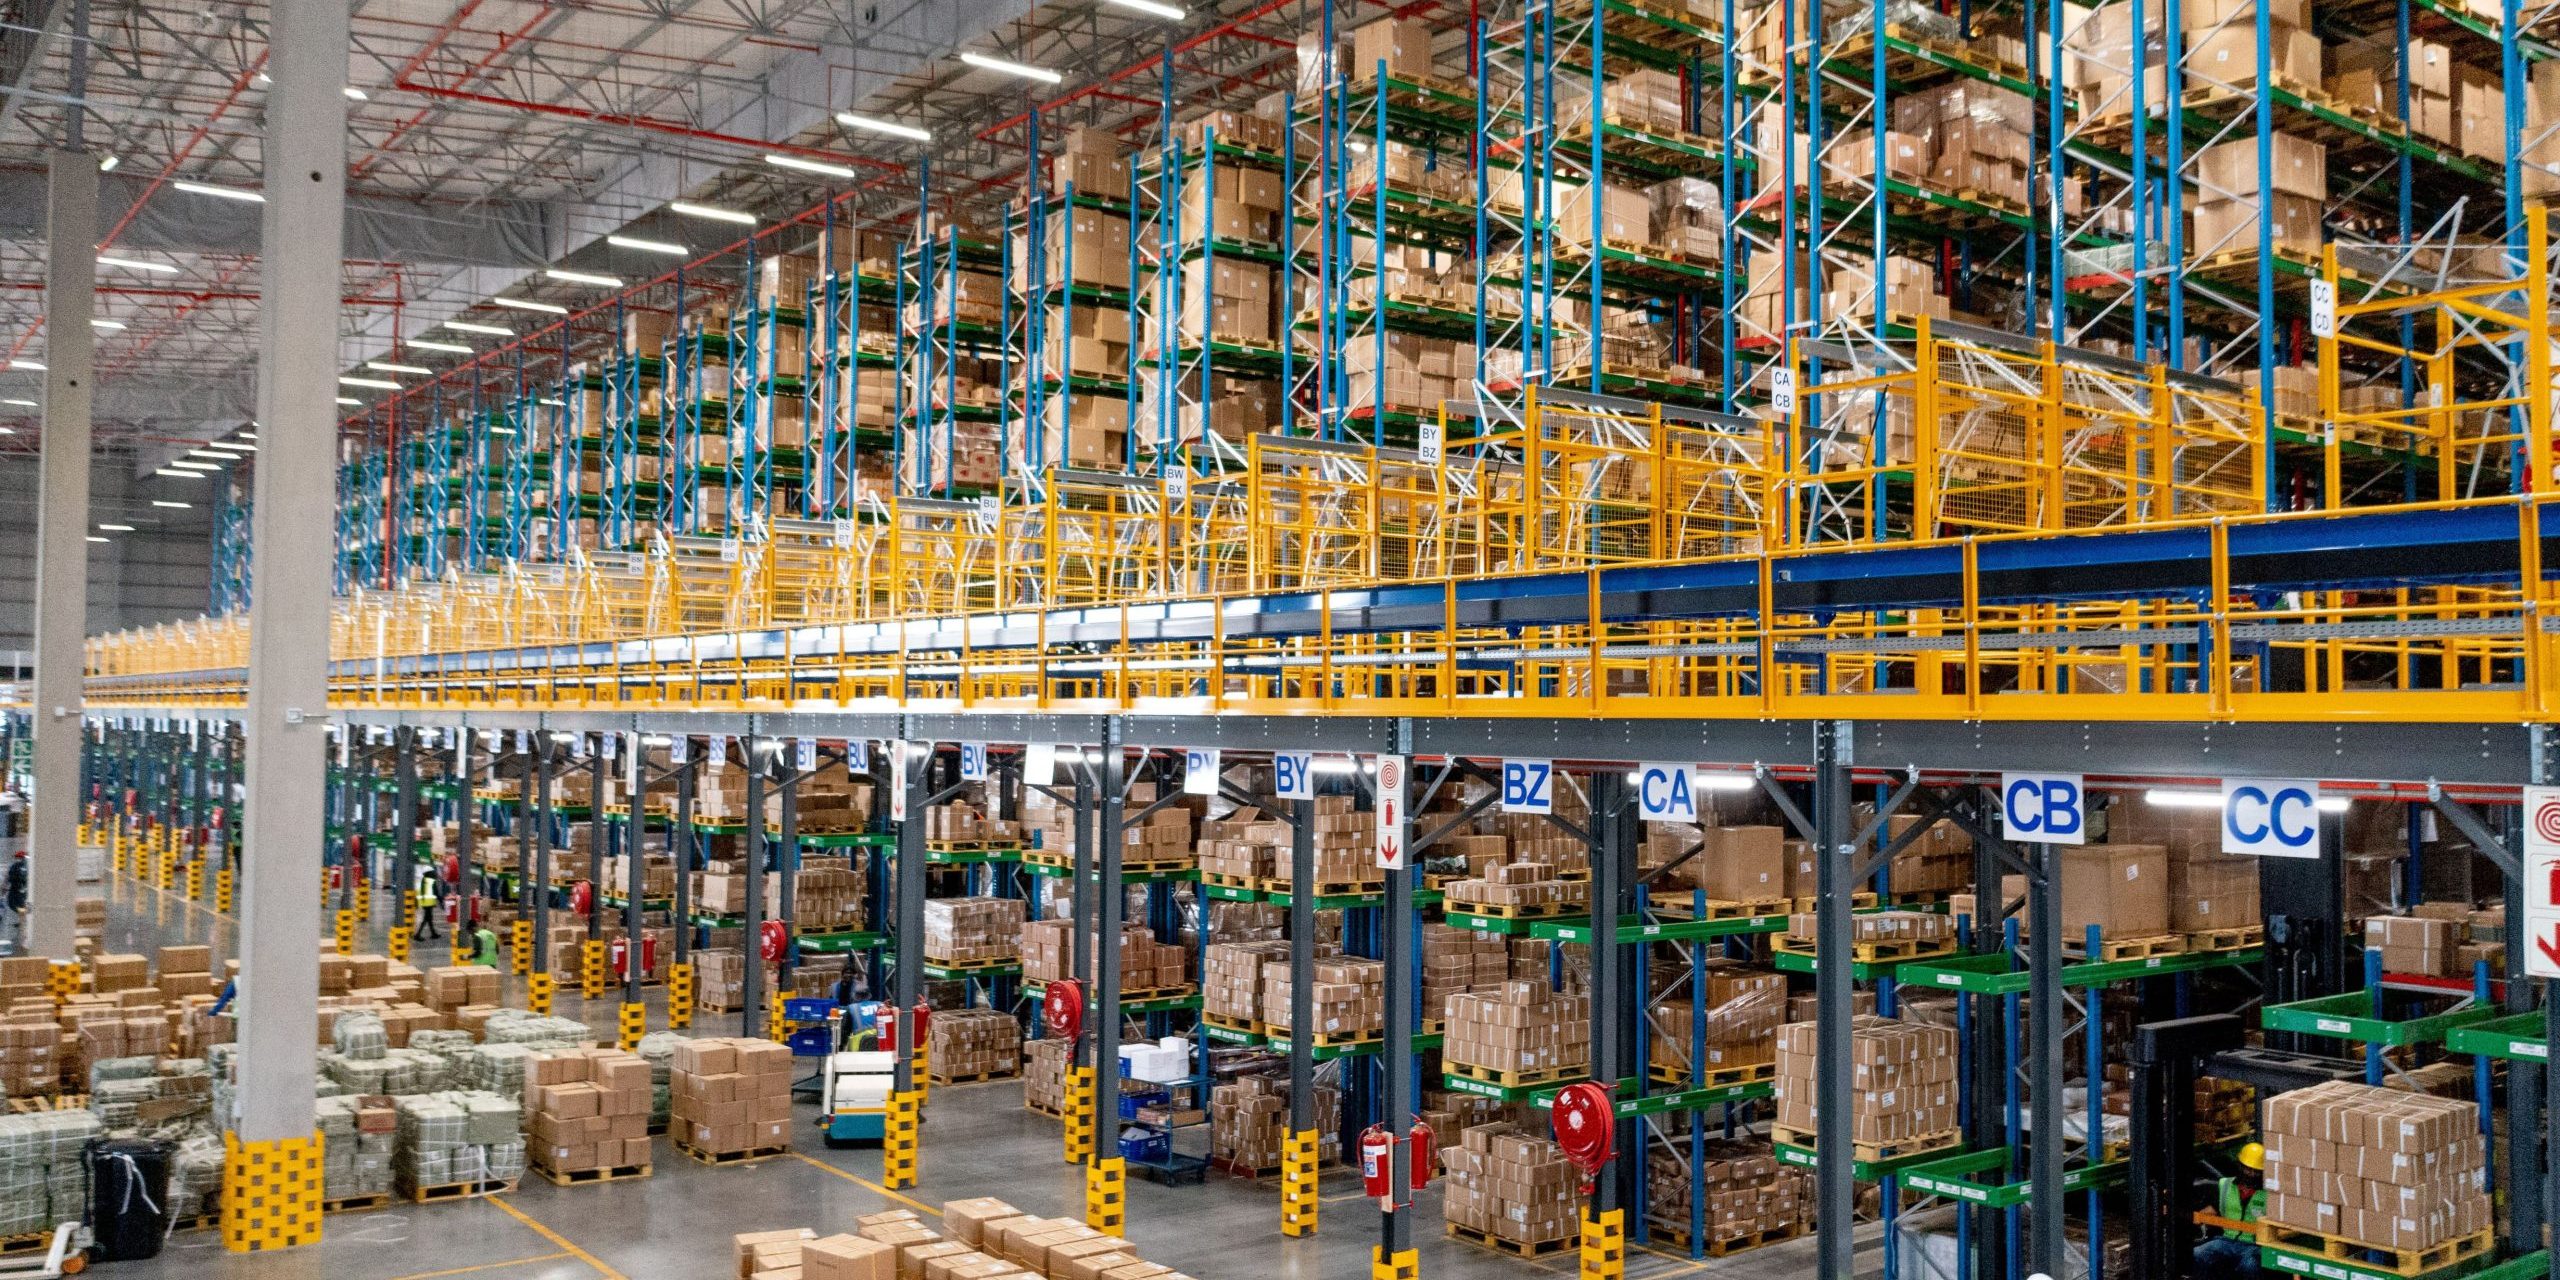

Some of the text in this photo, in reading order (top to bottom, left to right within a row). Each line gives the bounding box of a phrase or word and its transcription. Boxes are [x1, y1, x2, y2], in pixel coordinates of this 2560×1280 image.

[2315, 285, 2328, 303] CC
[2315, 313, 2329, 330] CD
[1775, 371, 1790, 386] CA
[1775, 394, 1790, 408] CB
[1423, 428, 1436, 440] BY
[1423, 447, 1436, 458] BZ
[1168, 469, 1183, 479] BW
[1169, 485, 1182, 494] BX
[984, 499, 996, 508] BU
[673, 736, 686, 760] BR
[711, 738, 725, 761] BS
[798, 740, 815, 767] BT
[849, 742, 867, 769] BU
[963, 745, 985, 776] BV
[1276, 755, 1310, 793] BY
[1504, 763, 1549, 807] BZ
[1642, 768, 1694, 814] CA
[2005, 778, 2081, 835] CB
[2226, 785, 2315, 848] CC
